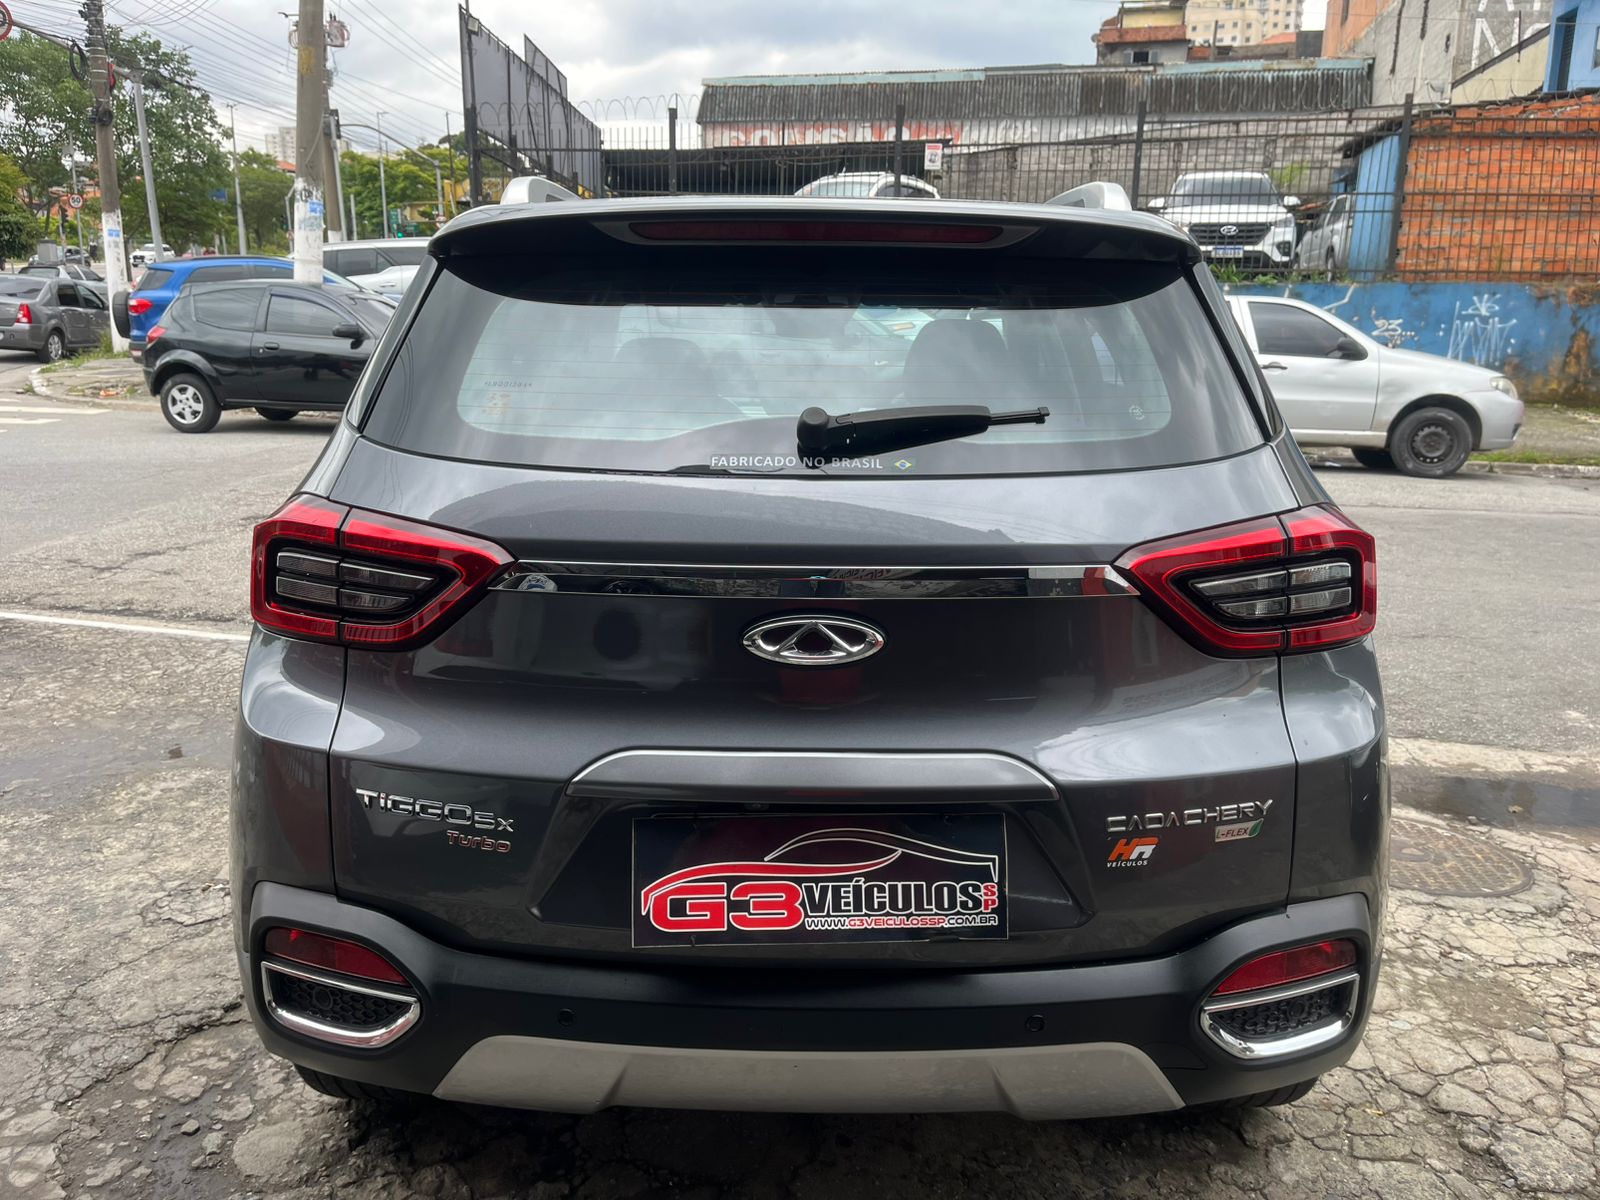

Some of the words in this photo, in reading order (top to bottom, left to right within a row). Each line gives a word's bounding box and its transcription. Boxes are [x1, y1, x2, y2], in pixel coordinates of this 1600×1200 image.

[711, 456, 796, 467] FABRICADO
[802, 456, 826, 468] NO
[832, 457, 883, 469] BRASIL
[447, 829, 511, 853] Turbo
[1107, 860, 1148, 868] VEÍCULOS
[650, 881, 804, 932] G3
[803, 877, 983, 915] VEÍCULOS
[804, 914, 998, 930] WWW.G3VEICULOSSP.COM.BR
